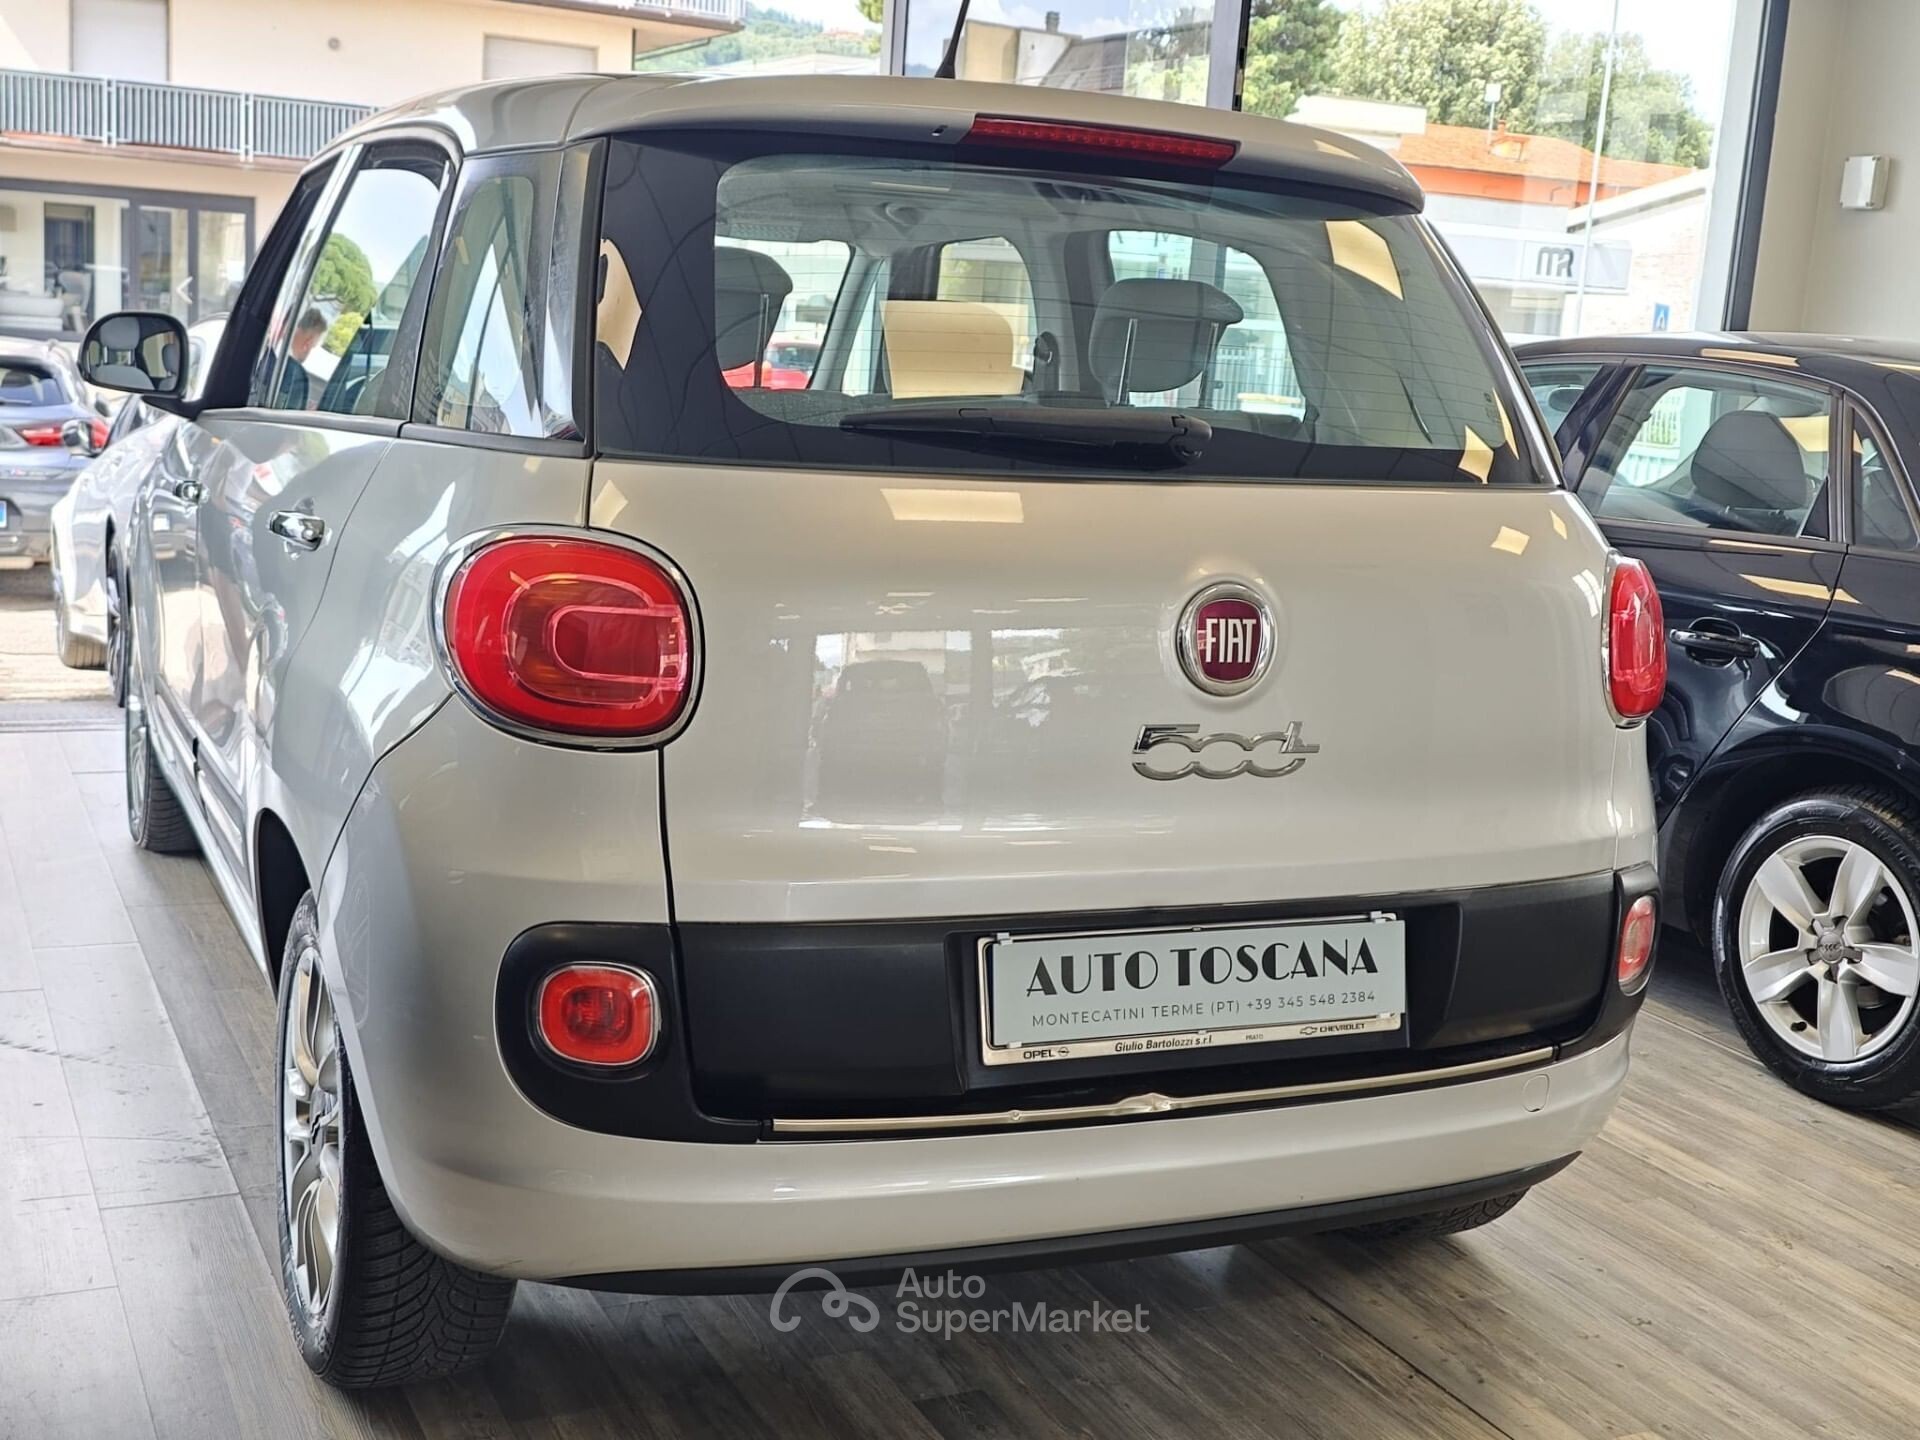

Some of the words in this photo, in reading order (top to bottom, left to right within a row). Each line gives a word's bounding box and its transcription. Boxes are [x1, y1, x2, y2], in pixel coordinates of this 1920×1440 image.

[1206, 618, 1257, 663] FIAT
[1132, 721, 1320, 781] 500L
[1027, 951, 1158, 997] AUTO
[1170, 937, 1378, 986] TOSCANA
[1032, 1007, 1145, 1027] MONTECATINI
[1152, 1001, 1204, 1018] TERME
[1211, 1000, 1240, 1016] (PT)
[1247, 998, 1272, 1010] +39
[1278, 996, 1304, 1009] 345
[1310, 993, 1336, 1006] 548
[1342, 991, 1375, 1004] 2384
[1115, 1041, 1143, 1052] Giulio
[1146, 1037, 1193, 1049] Bartolozzi
[1320, 1023, 1364, 1032] CHEVROLET
[1023, 1049, 1055, 1060] OPEL
